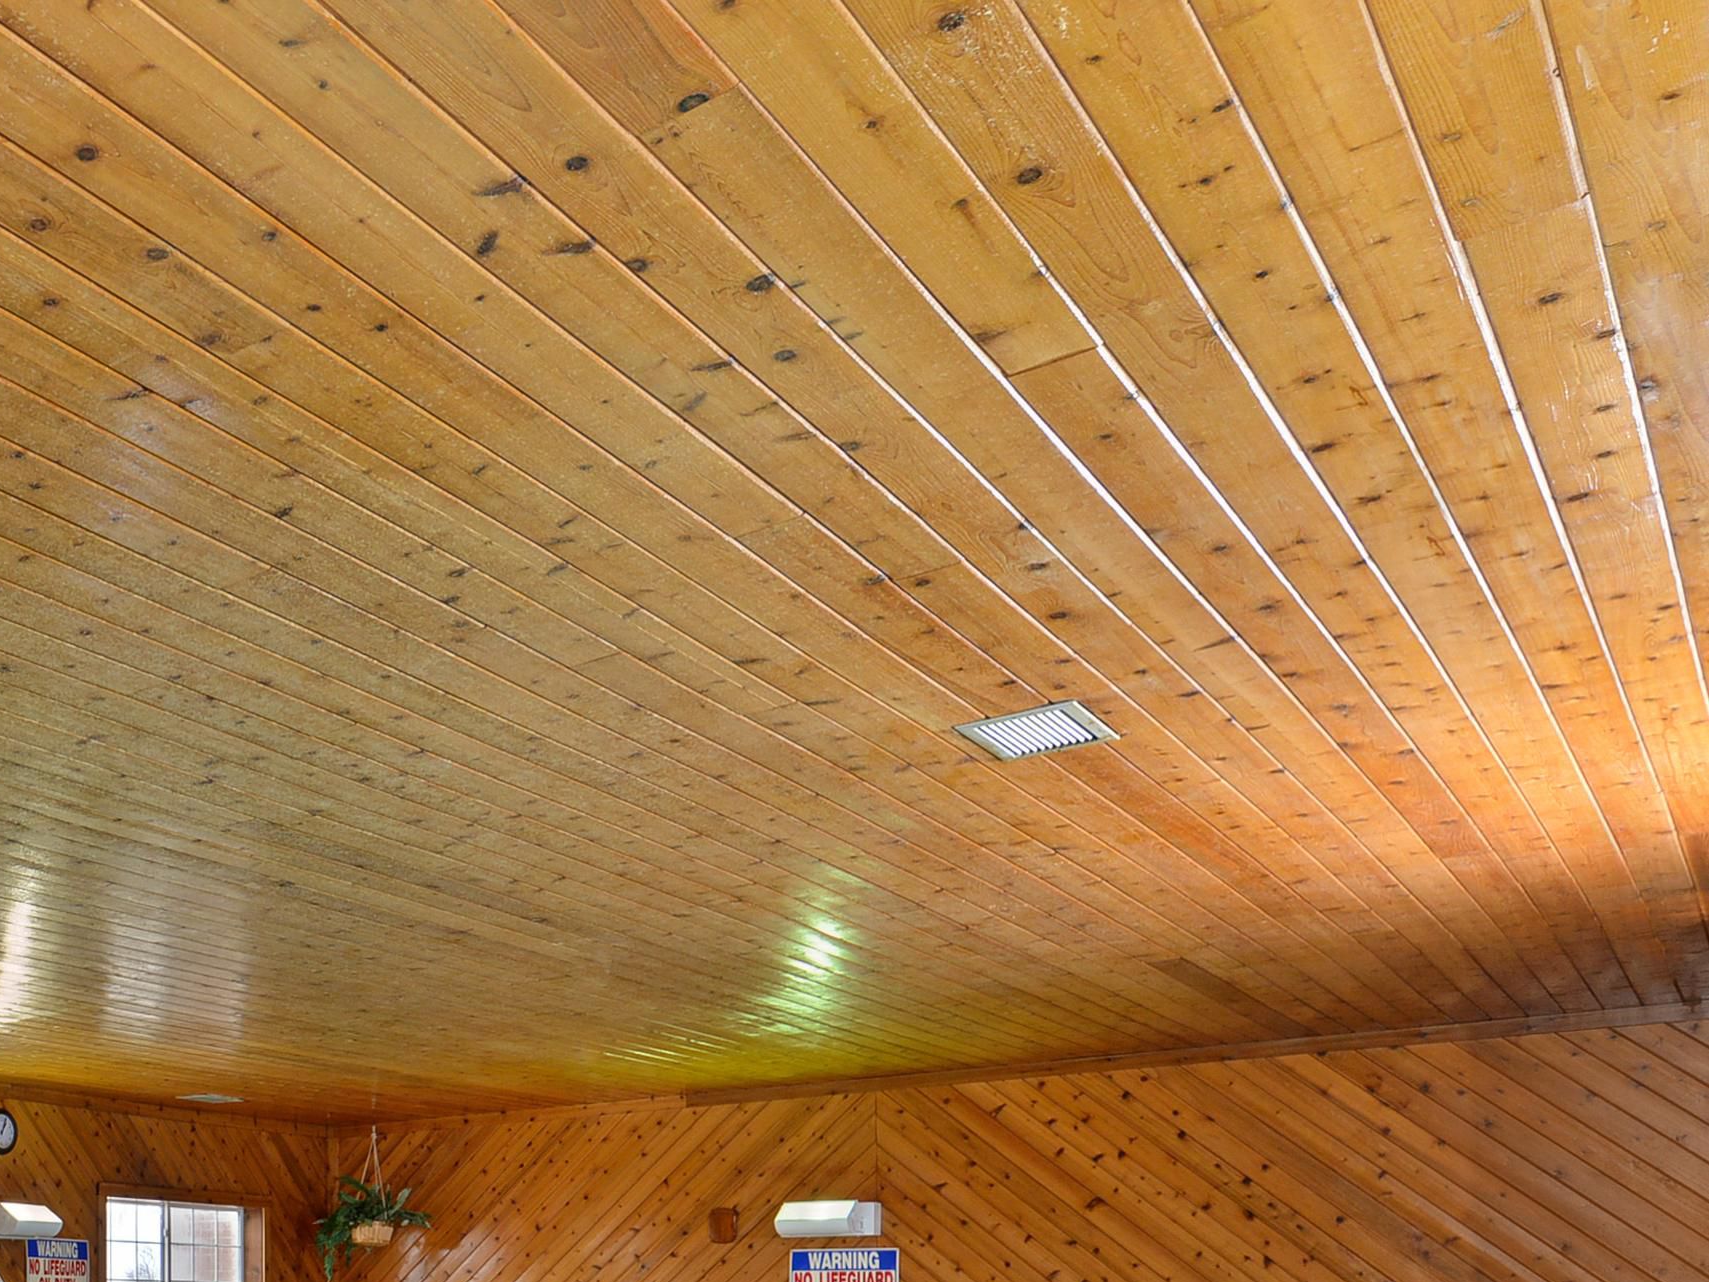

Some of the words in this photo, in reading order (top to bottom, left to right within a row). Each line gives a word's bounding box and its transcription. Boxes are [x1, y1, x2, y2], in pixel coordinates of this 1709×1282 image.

[36, 1240, 79, 1258] WARNING
[29, 1258, 40, 1275] NO
[44, 1259, 86, 1276] LIFEGUARD
[808, 1251, 880, 1270] WARNING
